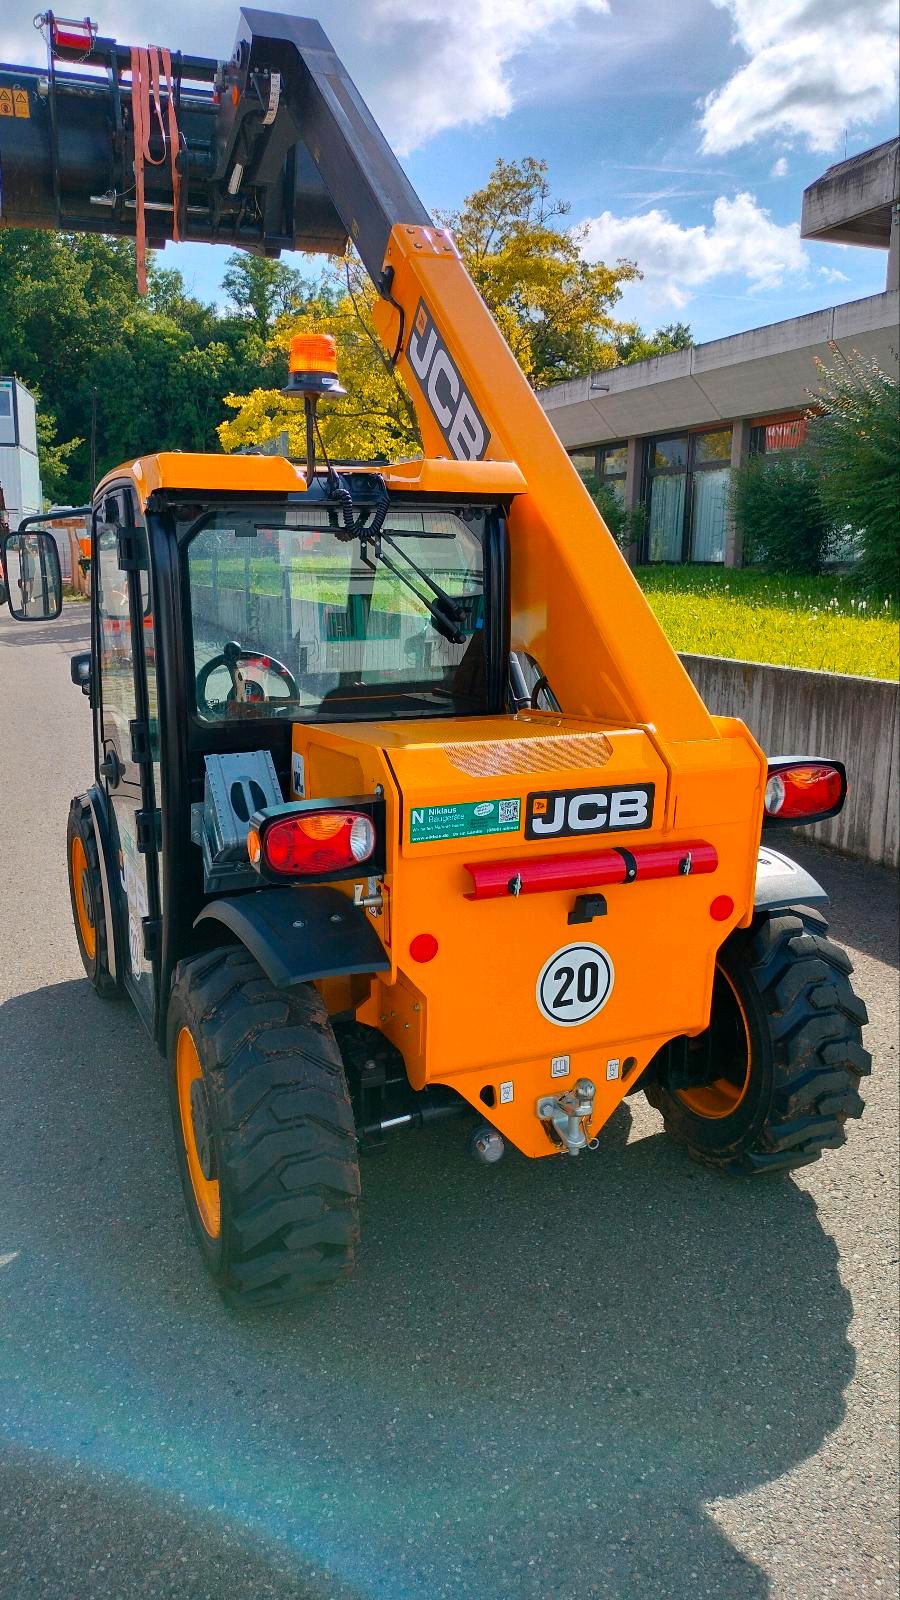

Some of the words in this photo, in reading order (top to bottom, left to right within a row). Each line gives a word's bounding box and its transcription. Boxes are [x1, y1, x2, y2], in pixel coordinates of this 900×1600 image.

[409, 328, 485, 461] JCB
[412, 809, 424, 824] N
[428, 807, 457, 815] Niklaus
[532, 790, 648, 834] JCB
[553, 962, 599, 1008] 20
